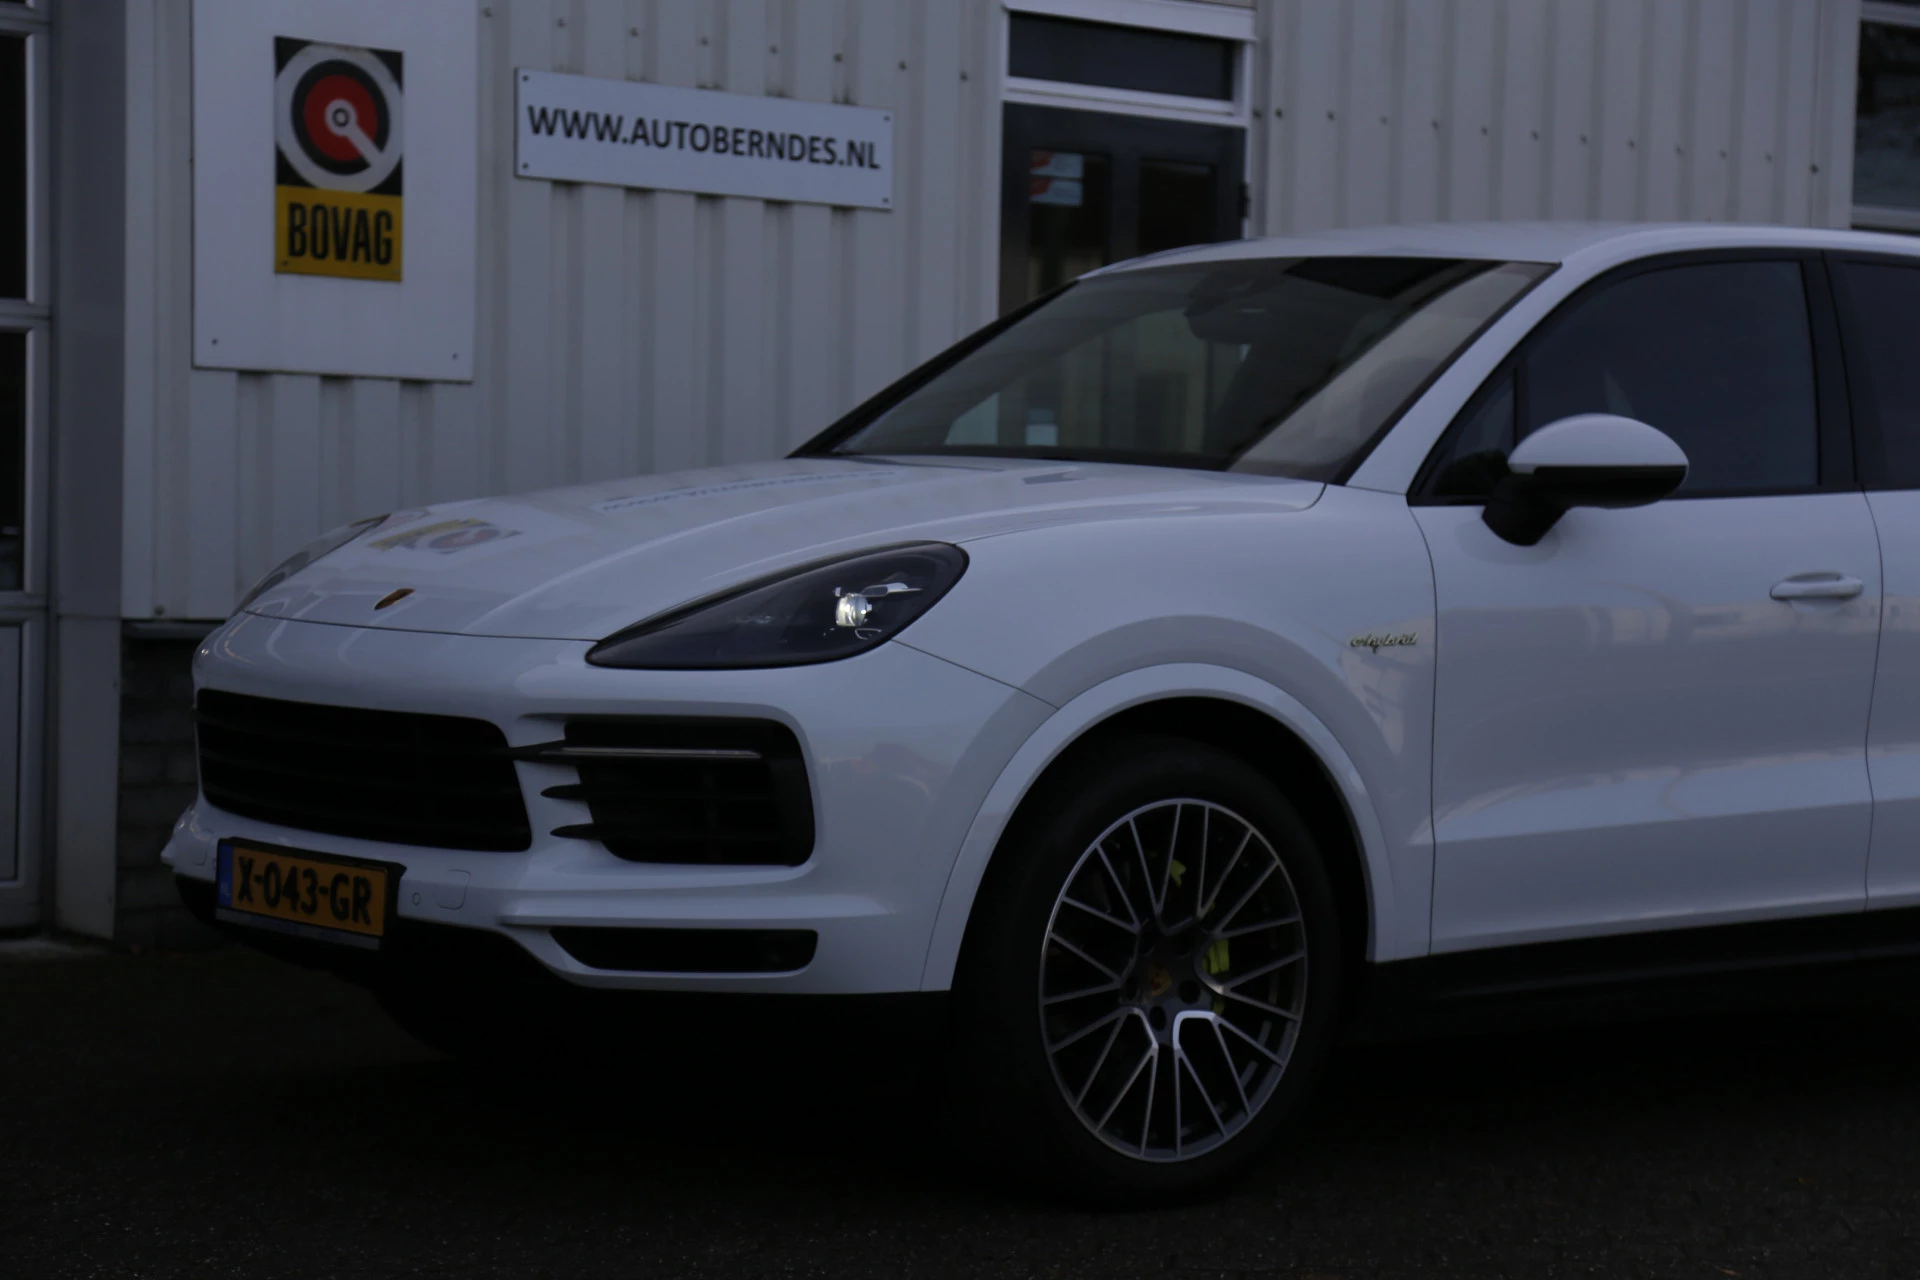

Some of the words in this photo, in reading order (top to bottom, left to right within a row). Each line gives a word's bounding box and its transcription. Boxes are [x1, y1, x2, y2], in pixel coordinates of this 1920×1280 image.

[527, 105, 880, 169] WWW.AUTOBERNDES.NL
[289, 202, 392, 265] BOVAG
[238, 856, 371, 925] X-043-GR
